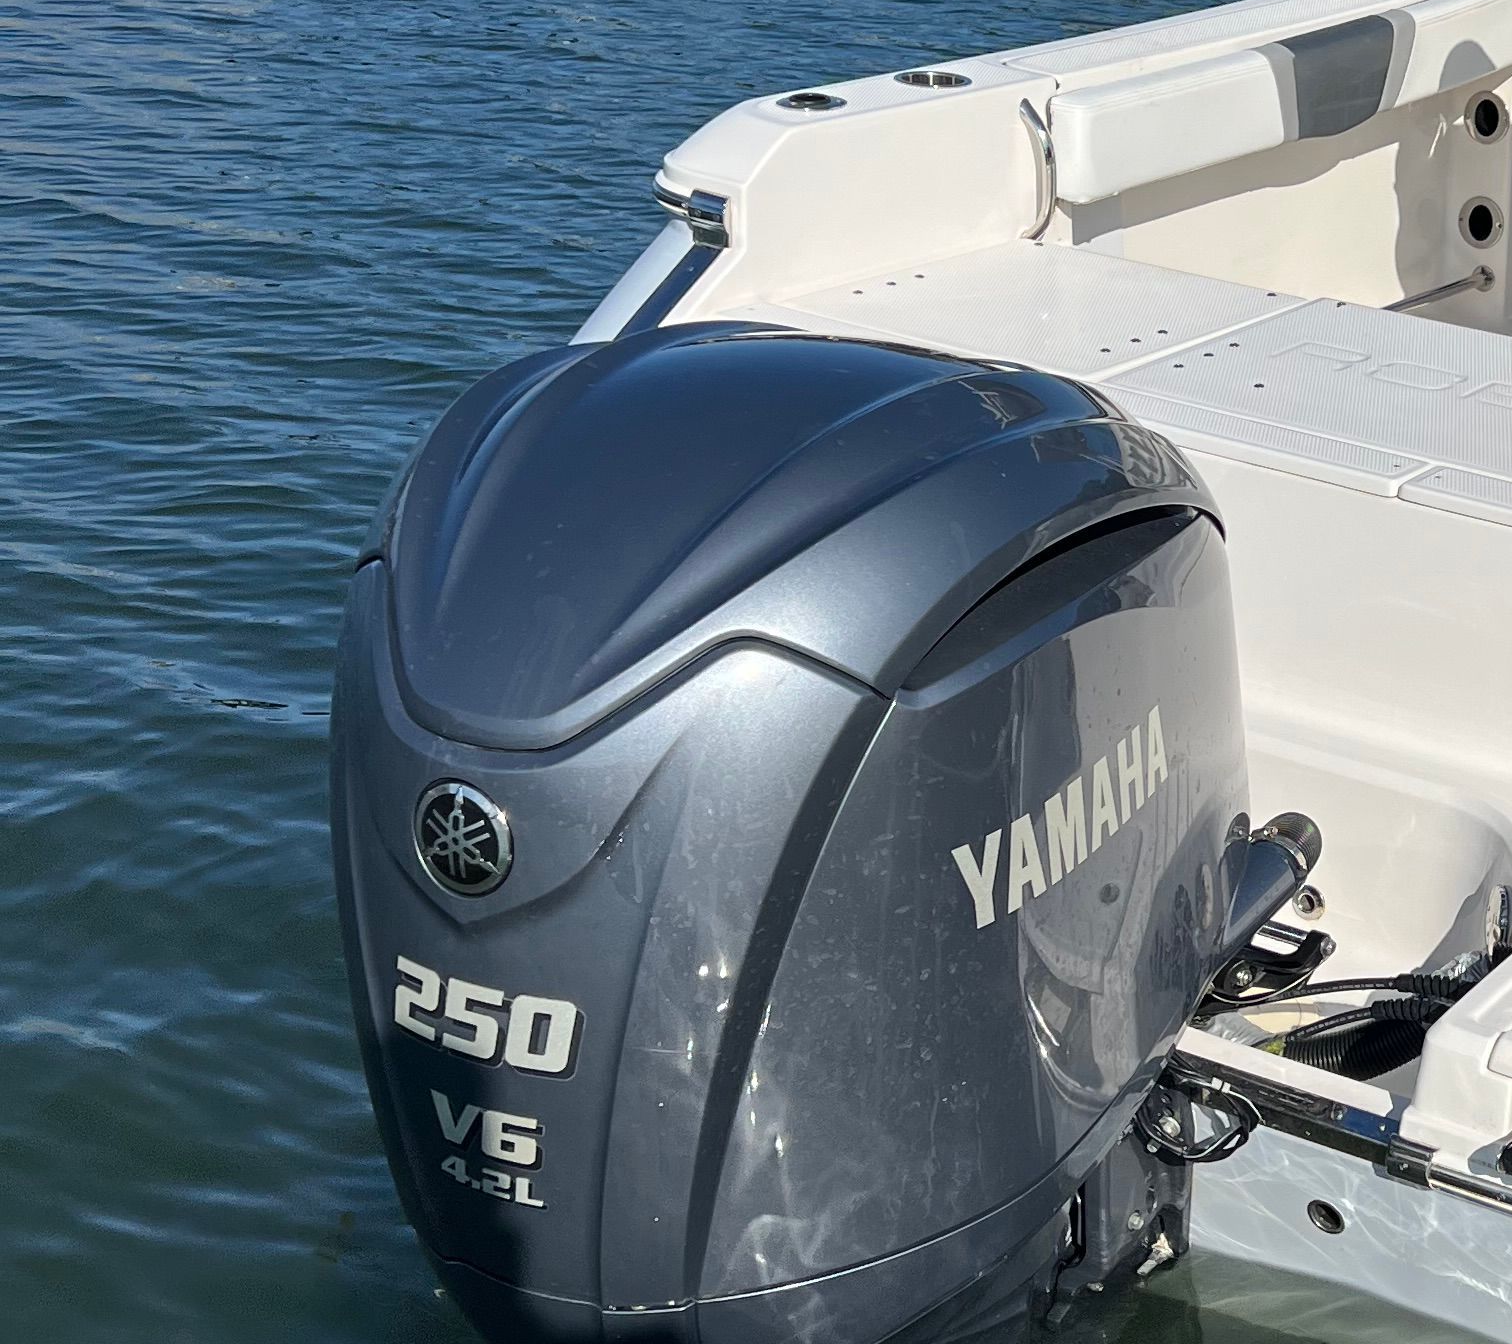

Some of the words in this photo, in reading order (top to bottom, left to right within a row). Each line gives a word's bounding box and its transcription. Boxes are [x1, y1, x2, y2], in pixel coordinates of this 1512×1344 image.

[951, 705, 1169, 929] YAMAHA
[394, 955, 583, 1078] 250
[430, 1088, 544, 1171] V6
[441, 1155, 546, 1208] 4.2L
